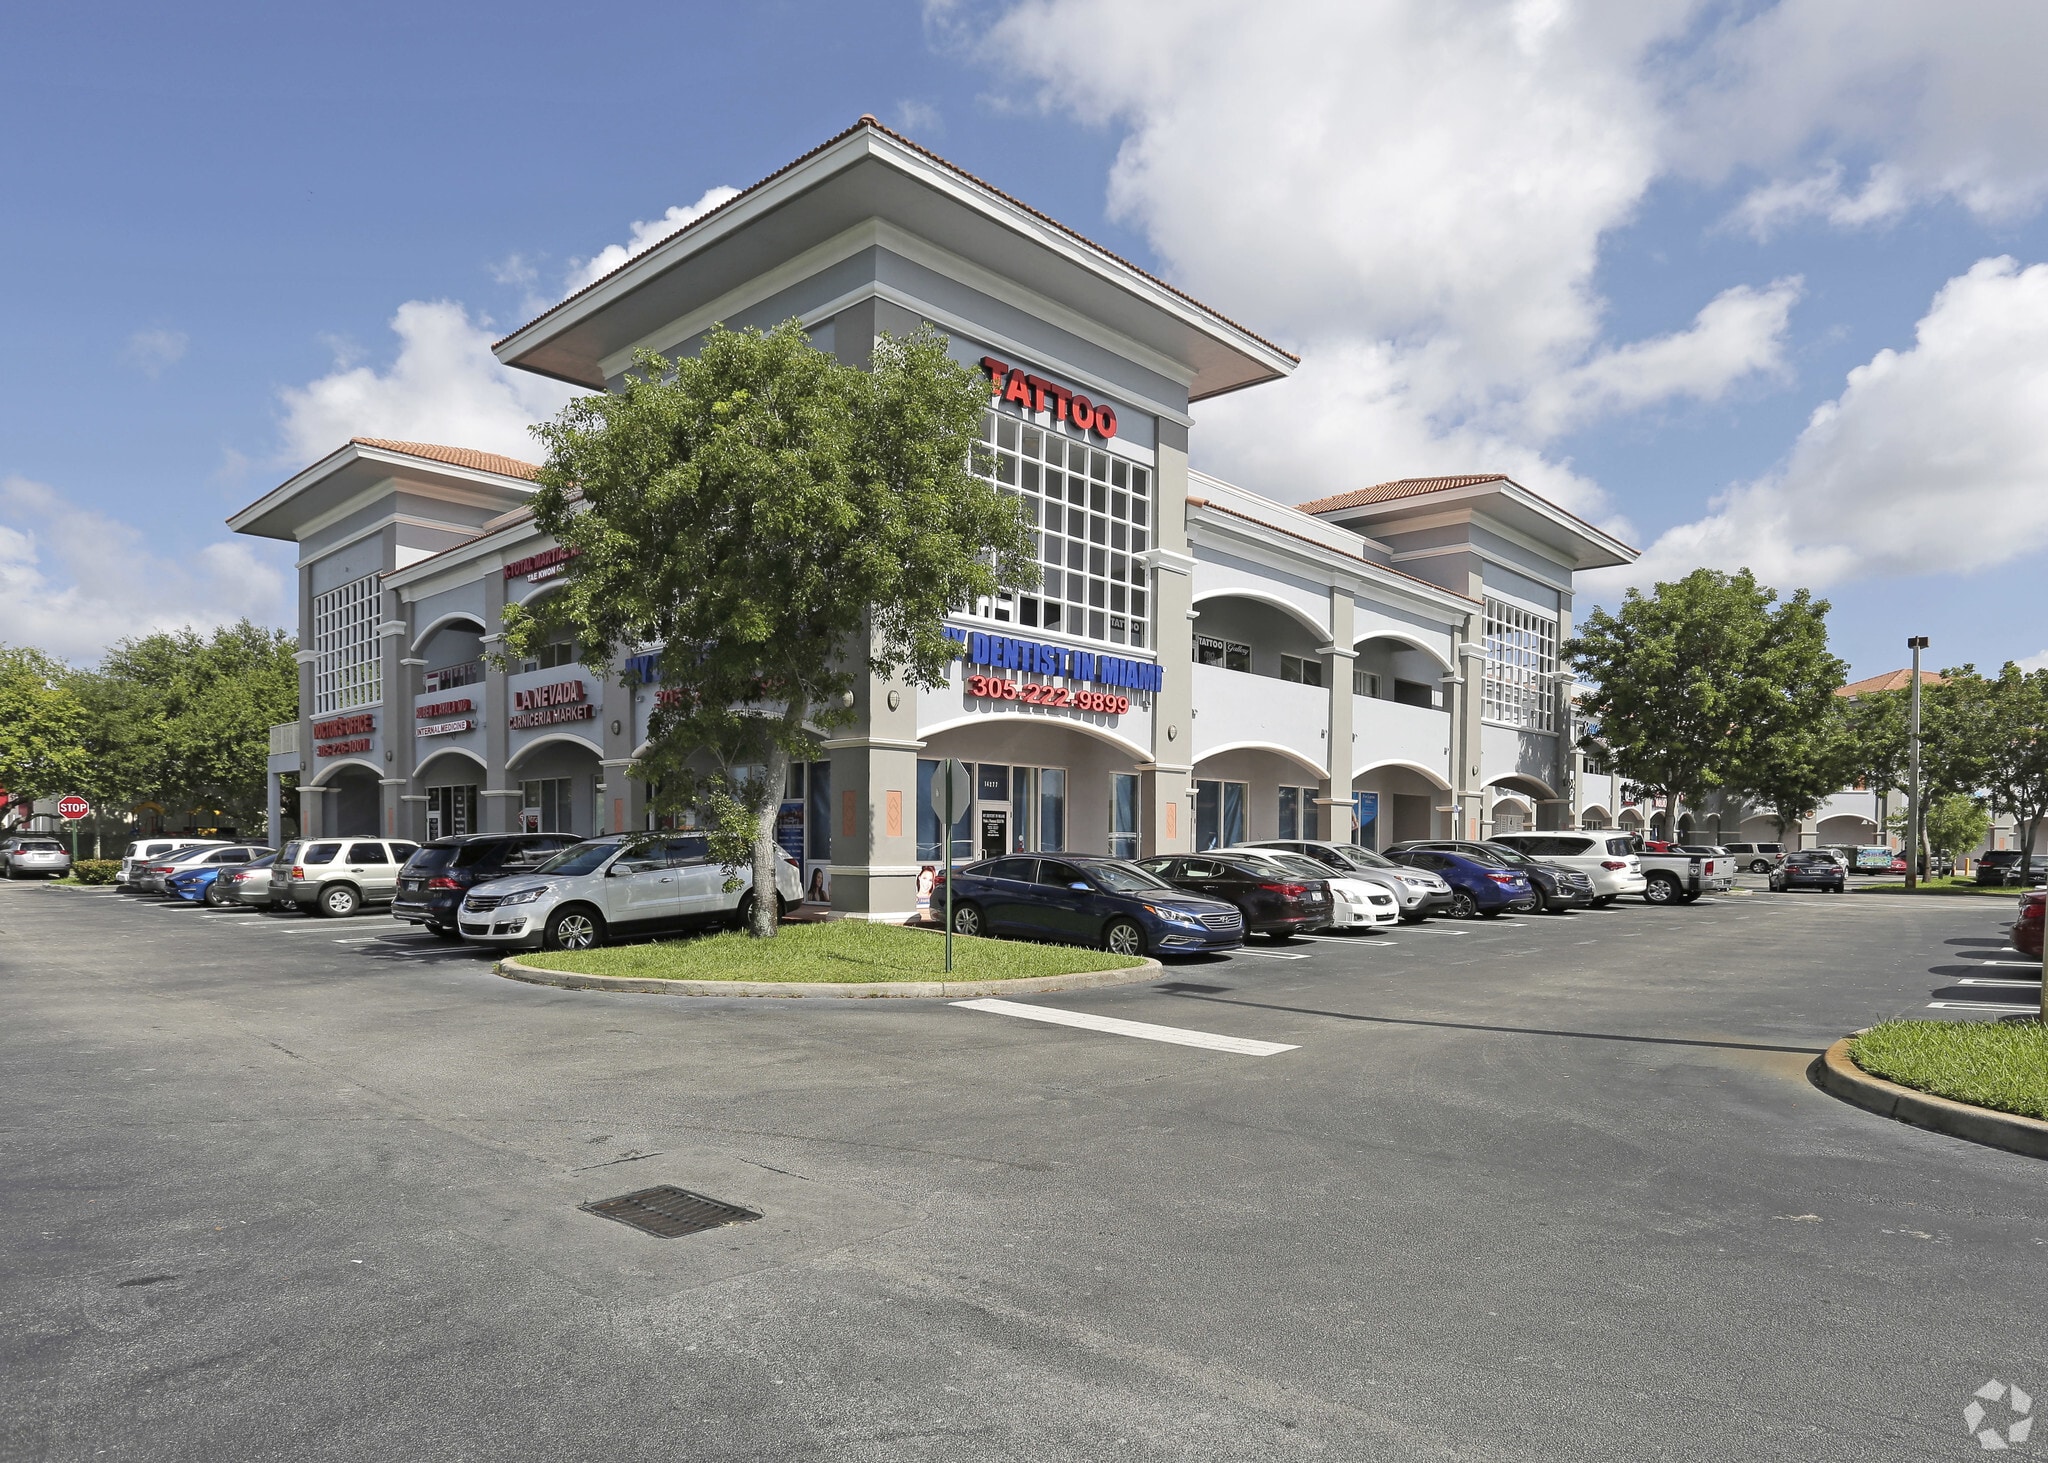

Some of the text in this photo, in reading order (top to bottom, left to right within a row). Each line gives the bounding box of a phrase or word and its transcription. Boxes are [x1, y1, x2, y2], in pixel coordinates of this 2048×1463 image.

[980, 356, 1118, 439] TATTOO
[527, 572, 537, 582] TAE
[538, 566, 555, 578] KWON
[1199, 637, 1249, 656] TATTOO Gallery
[968, 631, 1069, 678] DENTIST
[1070, 650, 1096, 682] IN
[1097, 654, 1162, 692] MIAMI
[514, 680, 580, 711] LA NEVADA
[967, 674, 1130, 715] 305-222-9899
[345, 714, 373, 735] OFFICE
[416, 721, 466, 736] INTERNAL MEDICINE
[508, 704, 589, 730] CARNICERIA MARKET
[60, 803, 87, 812] STOP
